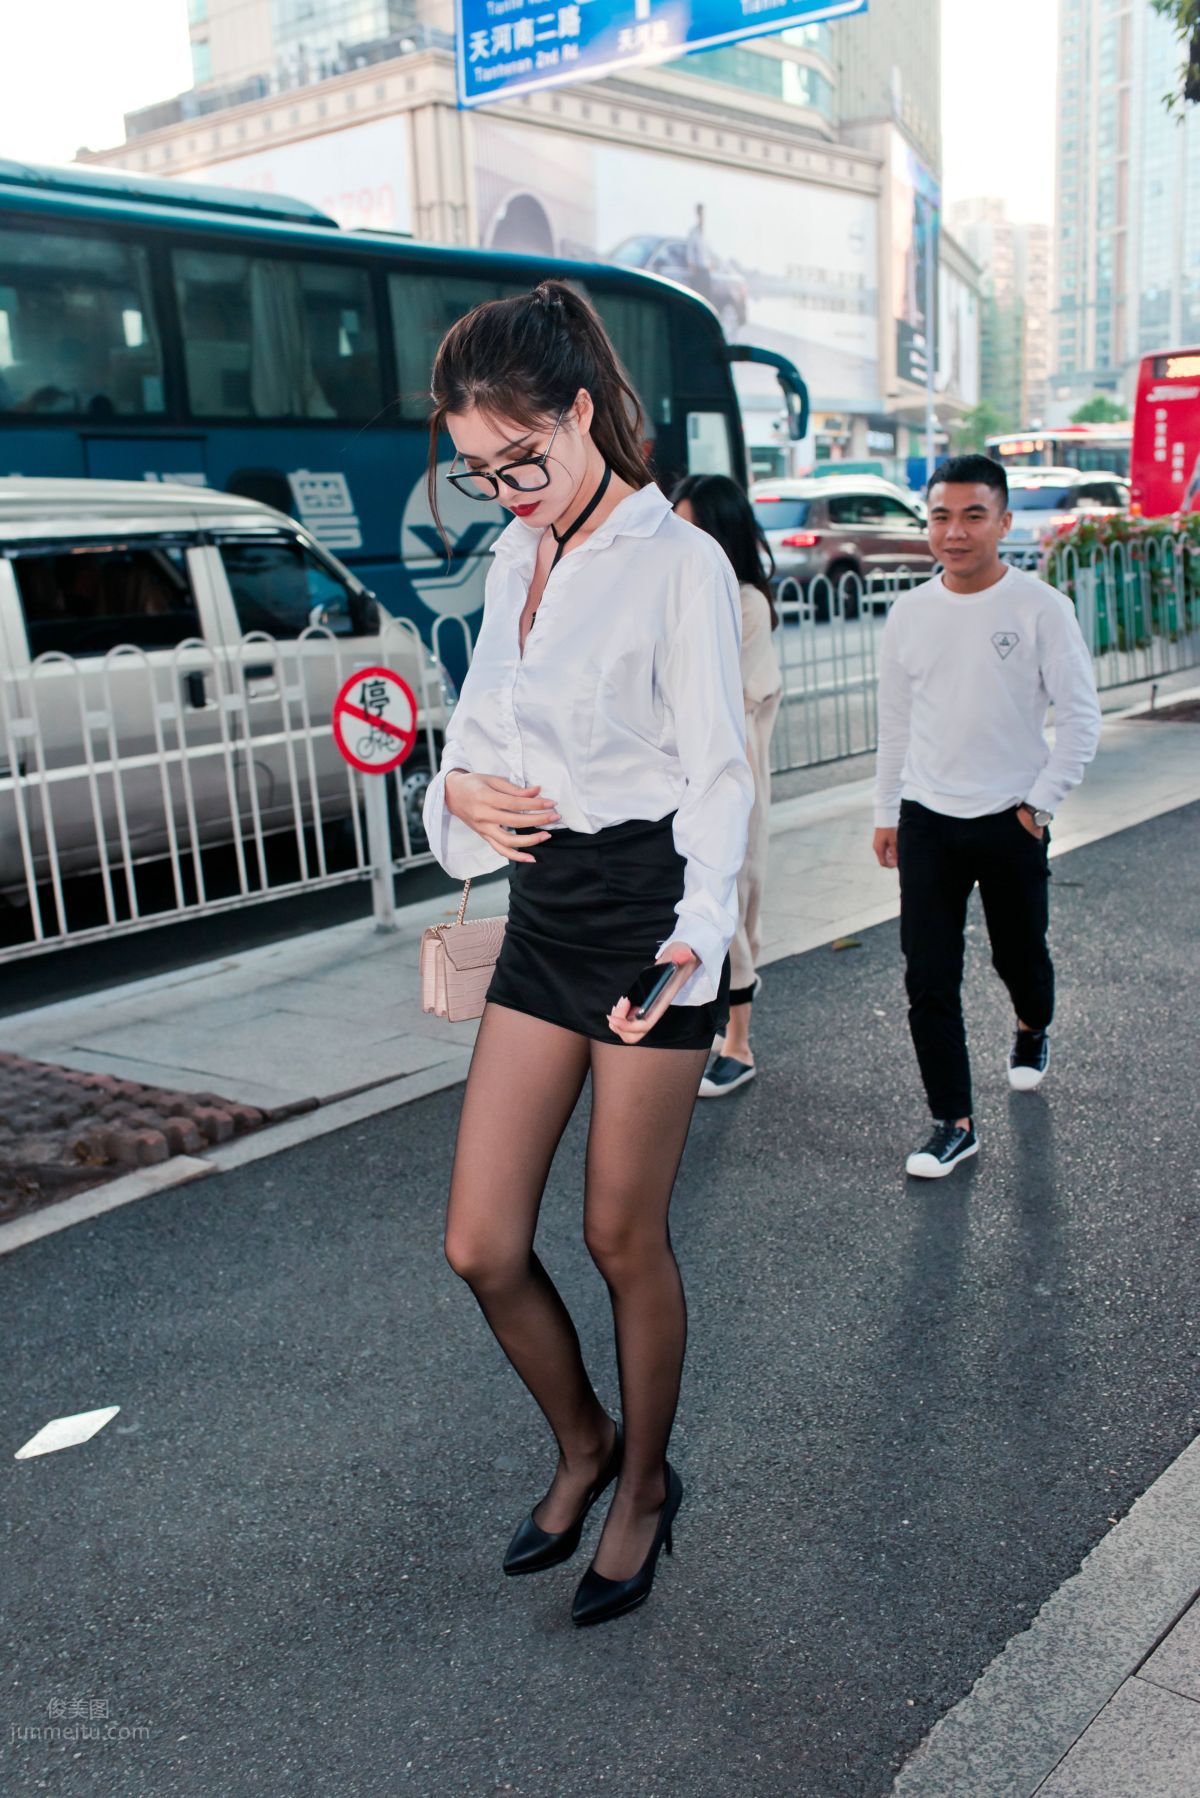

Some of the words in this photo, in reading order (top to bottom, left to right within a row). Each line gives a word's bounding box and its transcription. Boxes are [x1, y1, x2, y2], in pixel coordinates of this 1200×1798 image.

[468, 4, 582, 63] 天河南二路
[359, 680, 391, 721] 停
